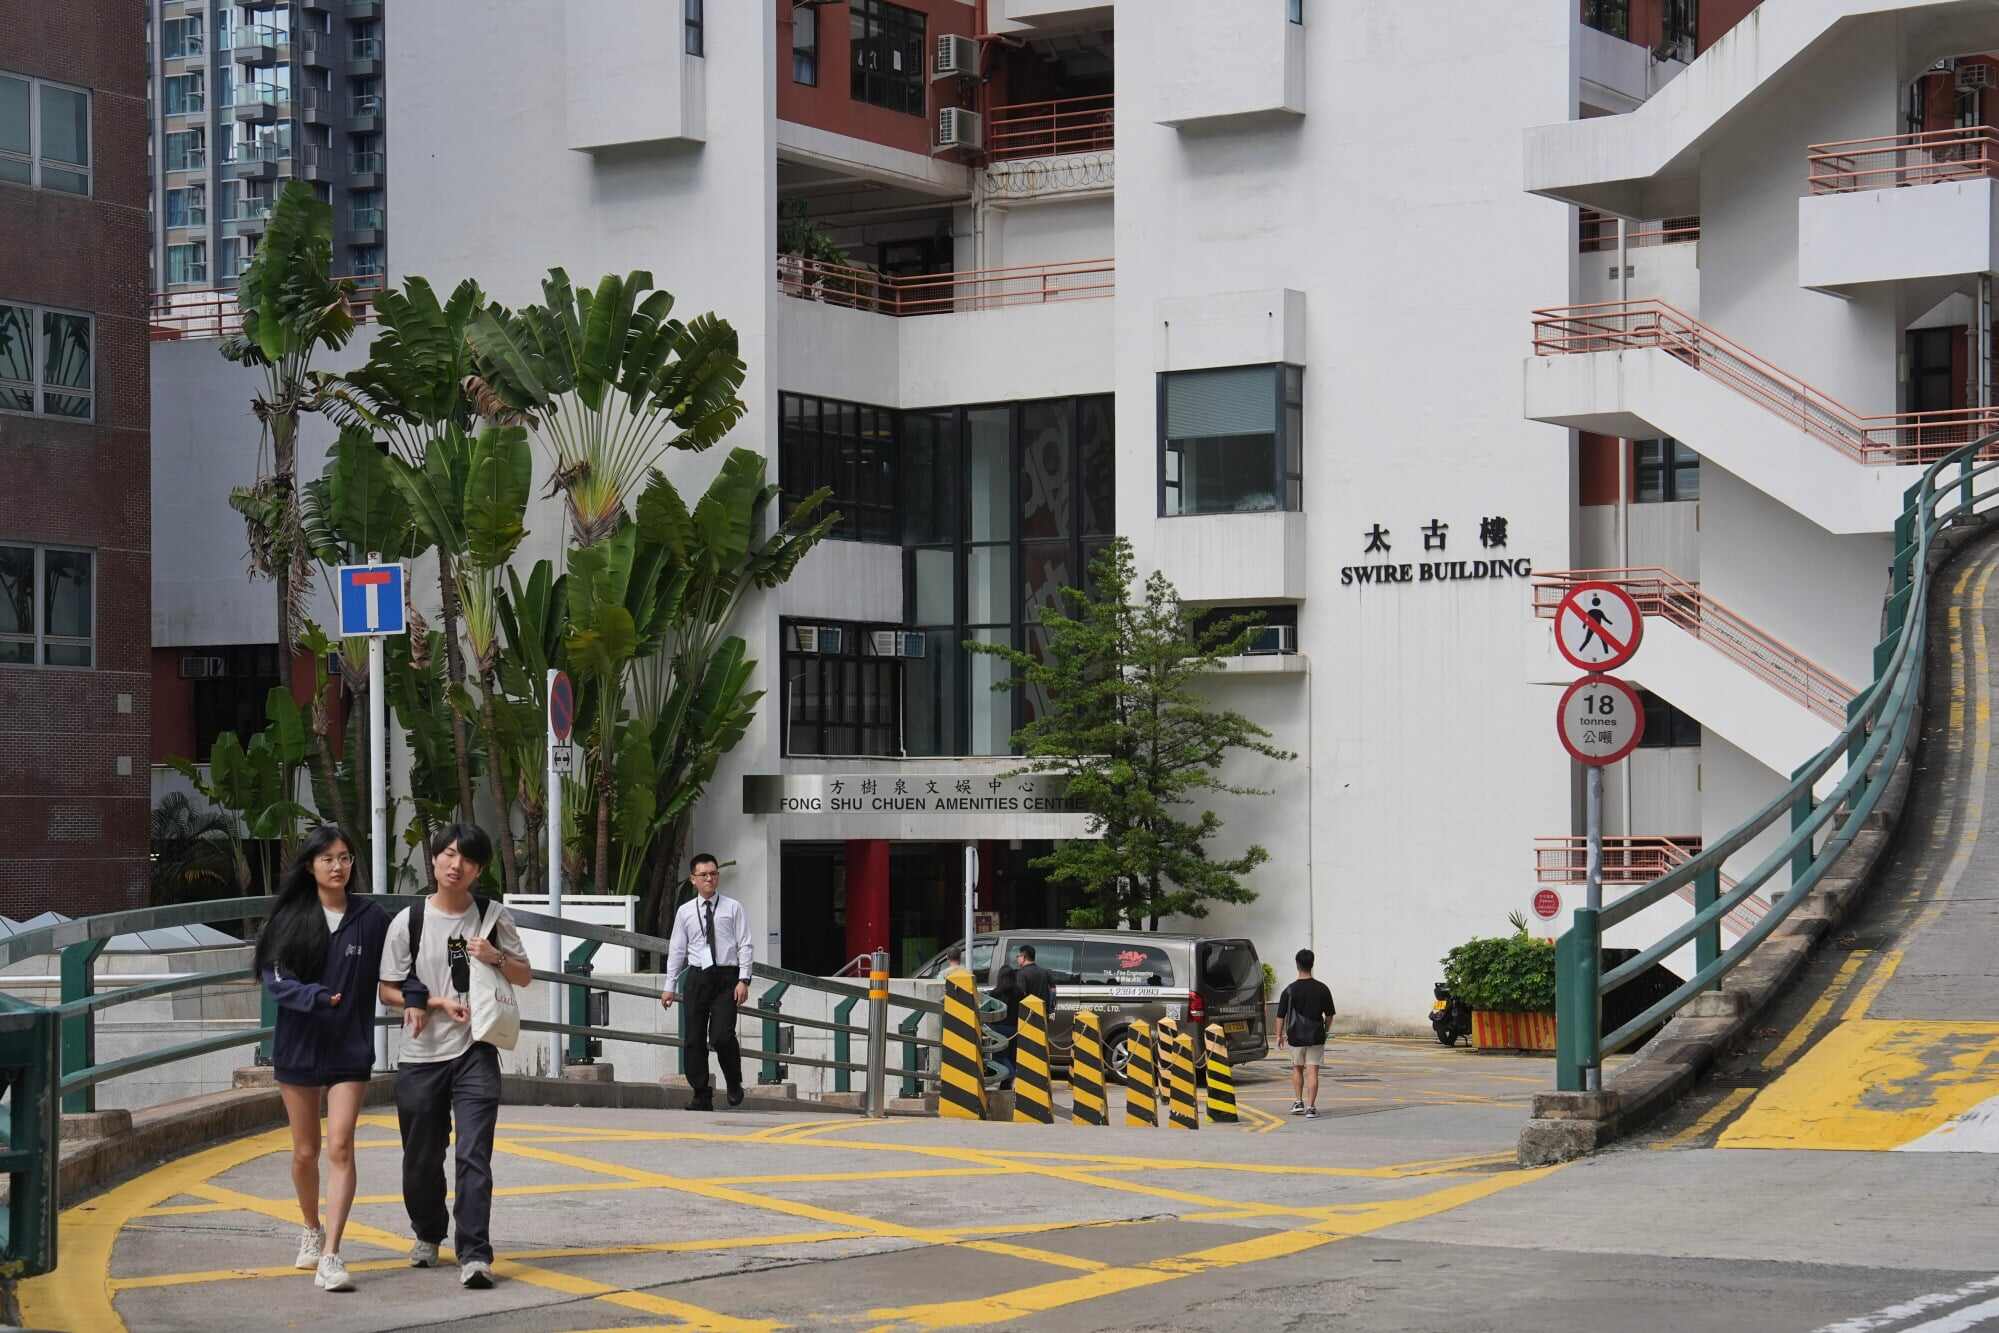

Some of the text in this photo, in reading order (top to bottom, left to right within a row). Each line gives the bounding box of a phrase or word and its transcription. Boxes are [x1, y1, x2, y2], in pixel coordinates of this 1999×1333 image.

[1364, 516, 1508, 553] 太古樓
[1340, 558, 1532, 586] SWIRE BUILDING
[1584, 695, 1614, 715] 18
[1580, 717, 1617, 726] tonnes
[1583, 730, 1613, 744] 公噸
[780, 798, 822, 810] FONG
[830, 798, 863, 810] SHU
[872, 798, 926, 810] CHUEN
[935, 797, 1019, 810] AMENITIES
